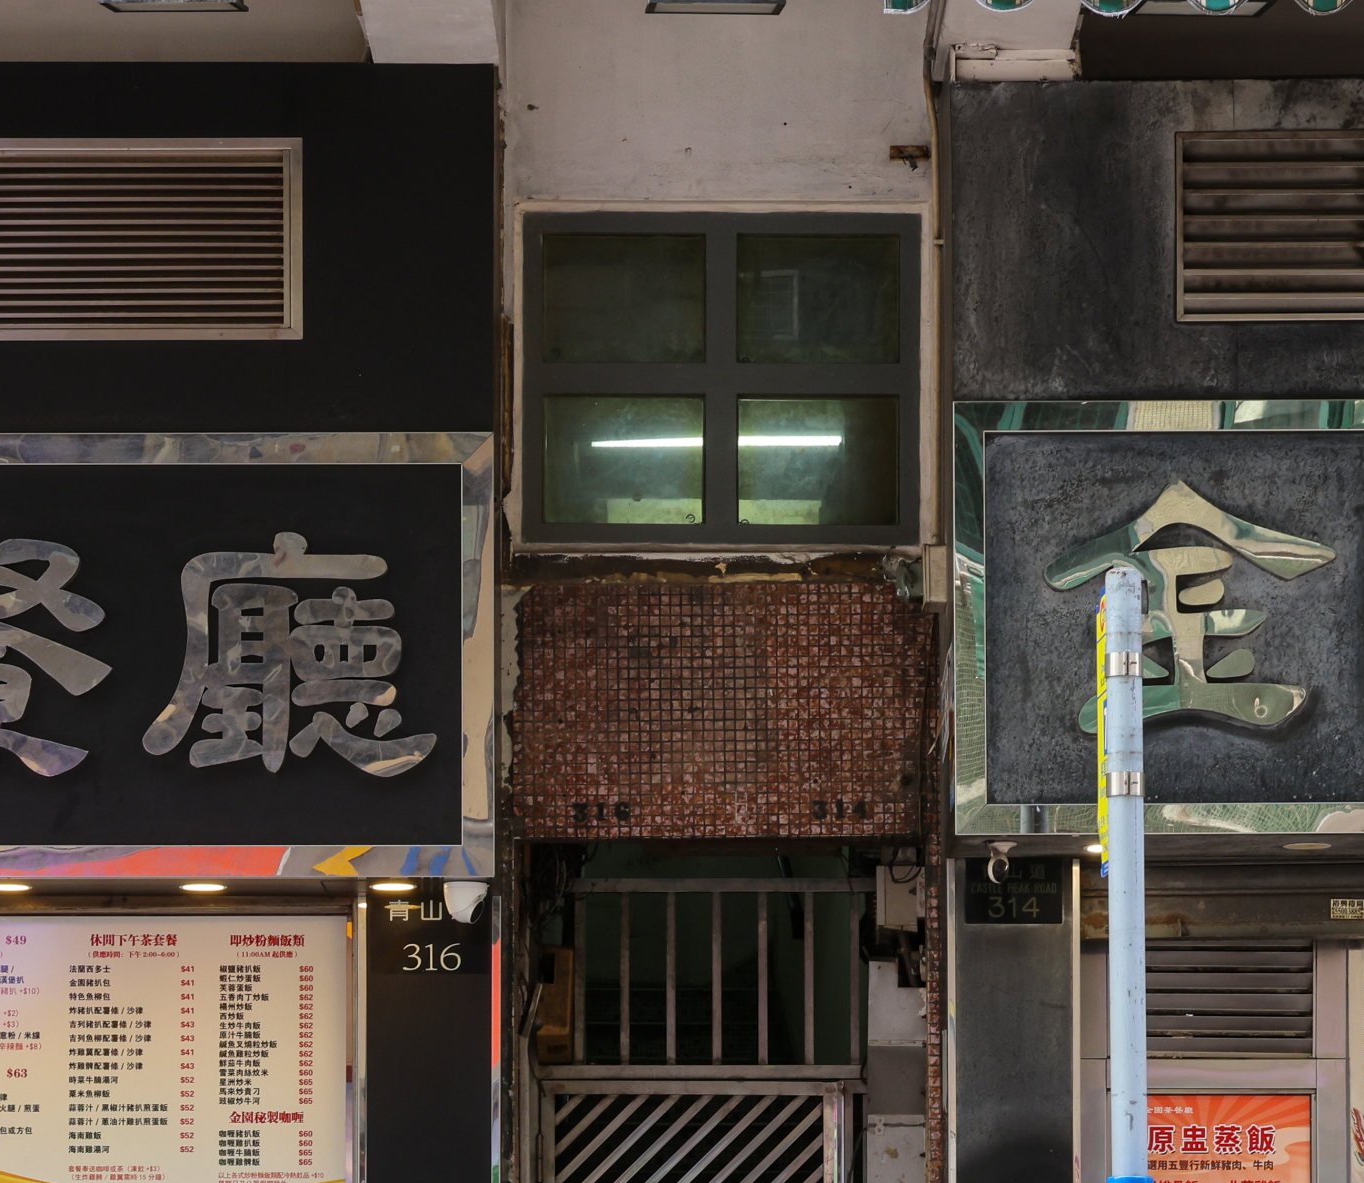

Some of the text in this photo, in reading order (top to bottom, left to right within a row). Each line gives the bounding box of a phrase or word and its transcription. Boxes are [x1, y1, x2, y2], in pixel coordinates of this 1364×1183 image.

[988, 896, 1040, 918] 314
[5, 935, 27, 945] $49
[230, 934, 305, 947] 即炒粉麵飯類
[402, 943, 461, 971] 316
[69, 965, 111, 974] 法蘭西多士
[69, 979, 195, 987] 金園豬扒包 $41
[219, 975, 261, 983] 蝦仁炒蛋飯
[69, 992, 111, 1001] 特色魚柳包
[219, 993, 269, 1001] 五香肉丁炒飯
[219, 1012, 244, 1020] 西炒飯
[219, 1022, 261, 1030] 生炒牛肉飯
[7, 1068, 28, 1079] $63
[219, 1078, 313, 1086] 星洲炒米 $65
[180, 1090, 195, 1098] $52
[69, 1131, 102, 1140] 海南雞飯
[1147, 1125, 1276, 1154] 原盅蒸飯
[298, 1139, 313, 1147] $60
[68, 1145, 194, 1153] 海南雞湯河 $52
